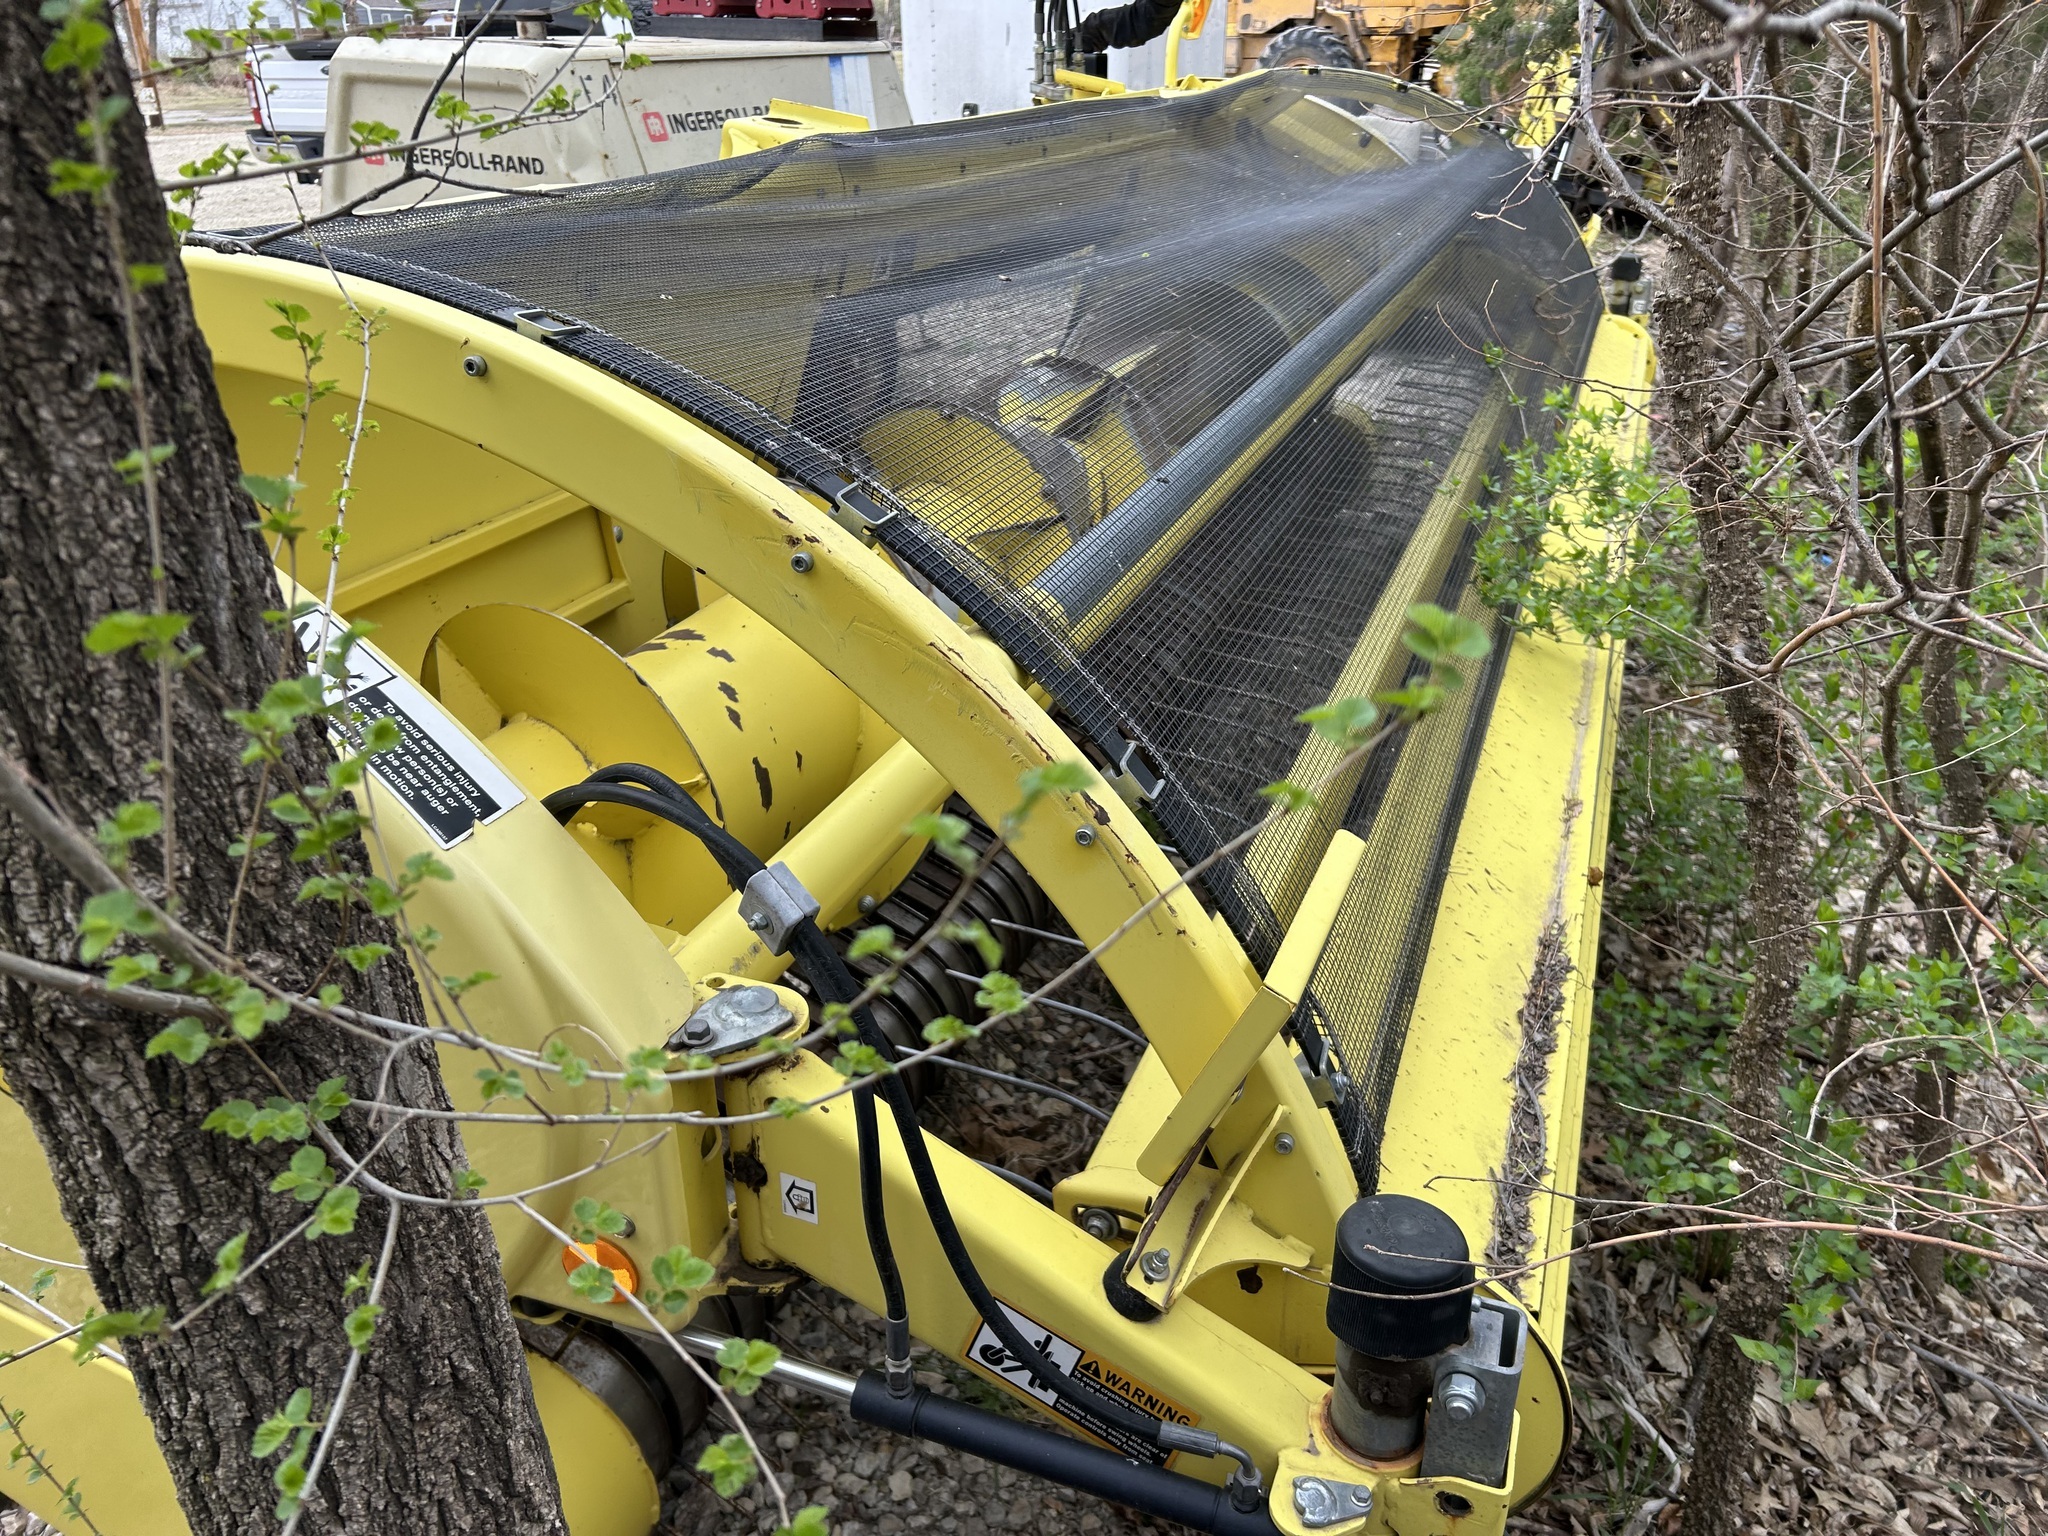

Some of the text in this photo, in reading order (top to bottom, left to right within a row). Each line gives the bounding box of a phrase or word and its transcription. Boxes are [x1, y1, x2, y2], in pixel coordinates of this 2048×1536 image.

[348, 701, 362, 714] do
[401, 754, 448, 798] person(s)
[446, 796, 459, 809] or
[359, 696, 372, 707] or
[400, 732, 421, 755] from
[420, 754, 481, 818] entanglement,
[370, 753, 382, 766] in
[380, 765, 415, 801] motion.
[383, 701, 396, 715] To
[396, 714, 424, 740] avoid
[421, 738, 455, 771] serious
[453, 770, 481, 798] injury
[386, 753, 450, 816] be near auger
[1058, 1398, 1086, 1417] machine
[1086, 1413, 1107, 1430] before
[1107, 1426, 1127, 1443] swing
[1074, 1370, 1081, 1378] To
[1082, 1376, 1100, 1389] avoid
[1100, 1387, 1129, 1409] crushing
[1130, 1404, 1150, 1420] injury
[1104, 1369, 1191, 1427] WARNING
[1055, 1402, 1081, 1422] Operate
[1080, 1418, 1107, 1438] controls
[1107, 1434, 1121, 1448] only
[1122, 1443, 1138, 1456] from
[1130, 1432, 1142, 1442] are
[1142, 1438, 1160, 1454] clear
[1159, 1450, 1168, 1459] of
